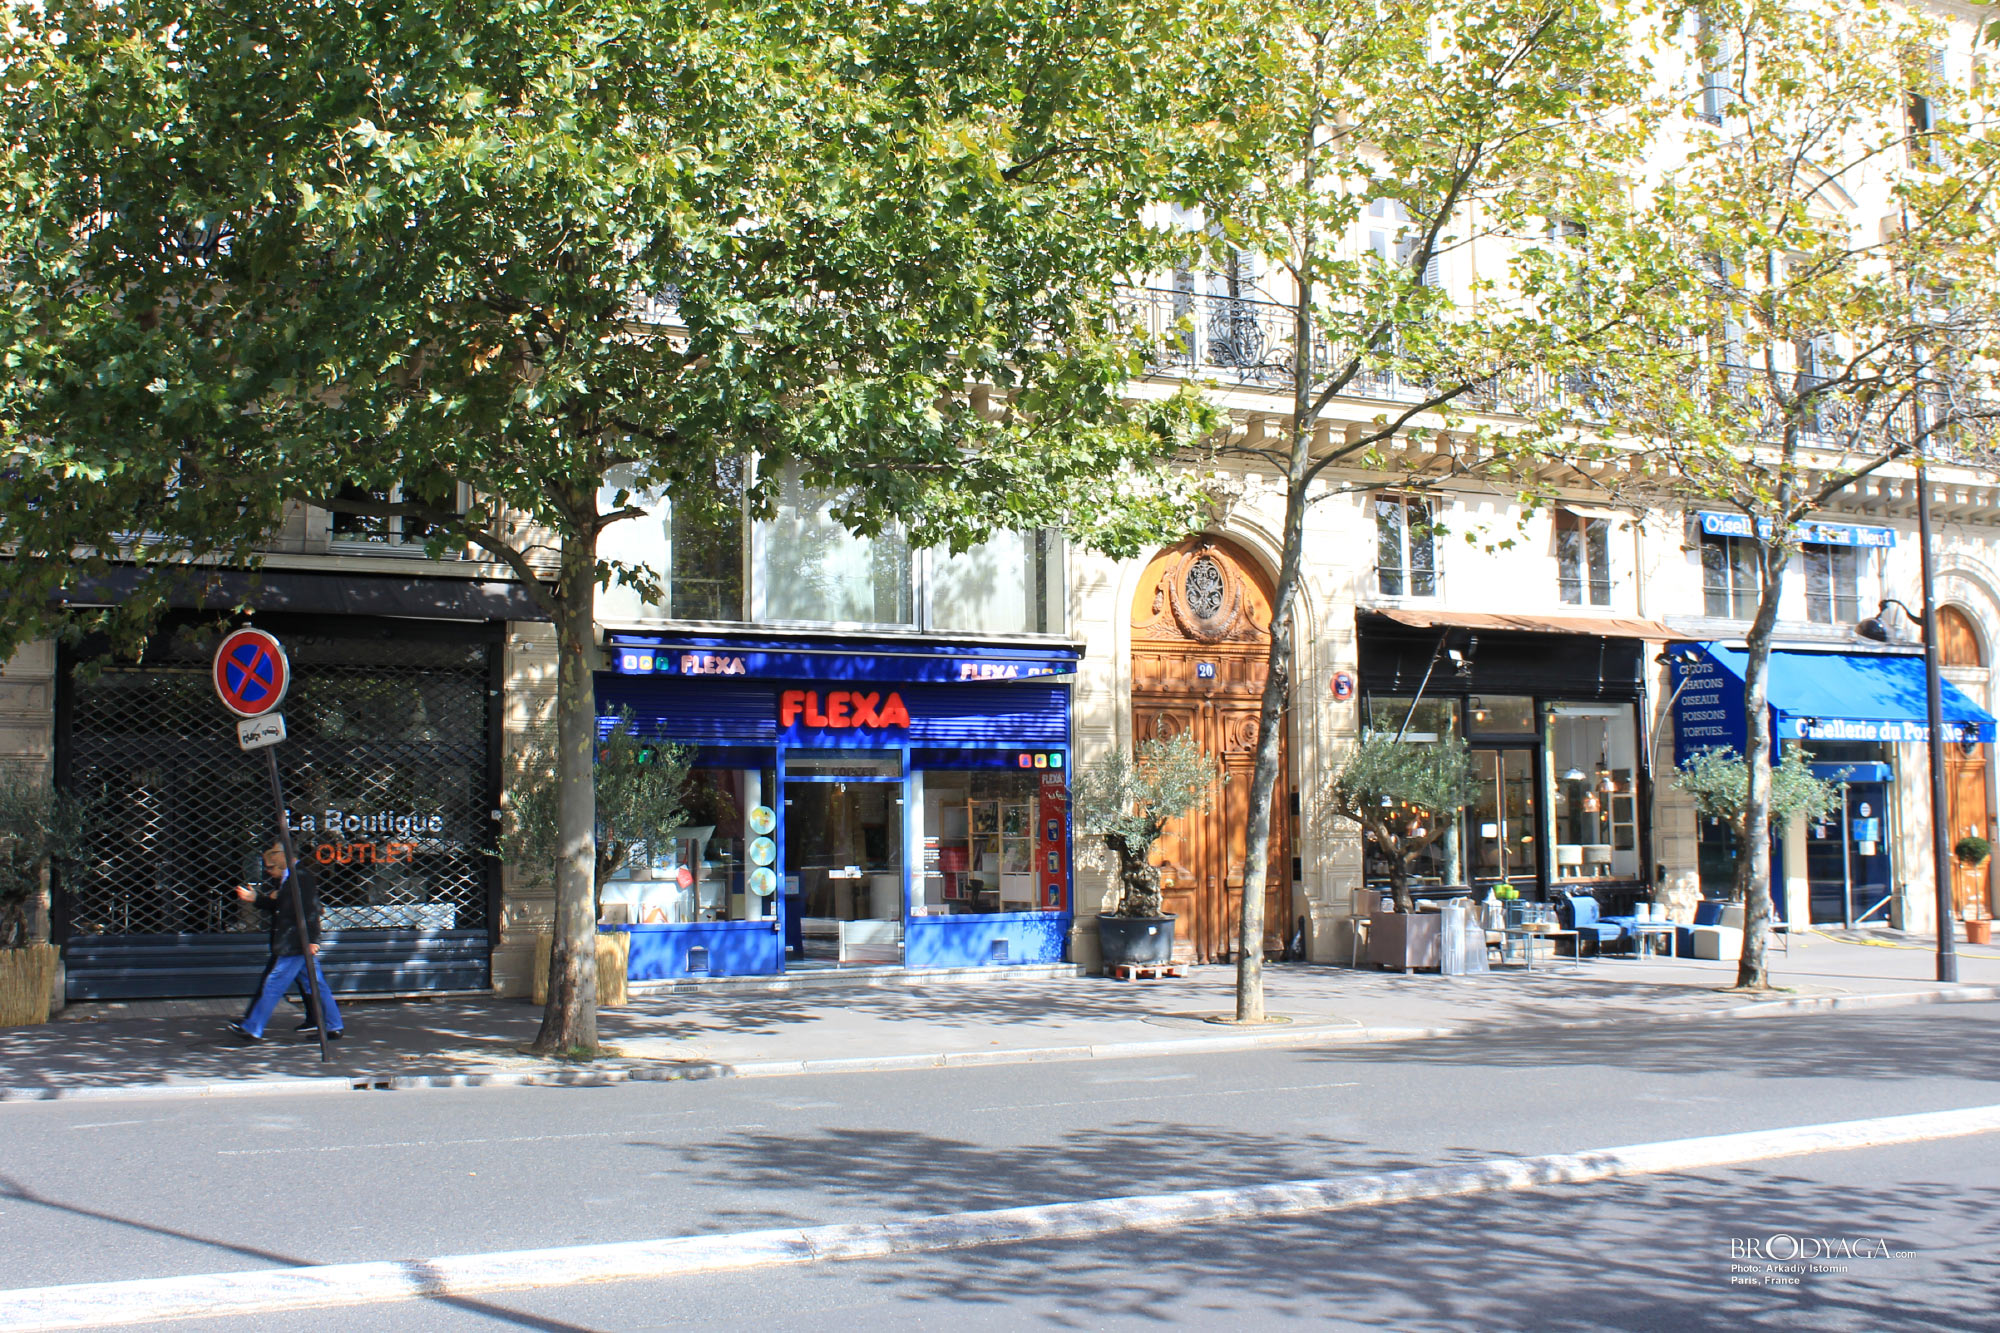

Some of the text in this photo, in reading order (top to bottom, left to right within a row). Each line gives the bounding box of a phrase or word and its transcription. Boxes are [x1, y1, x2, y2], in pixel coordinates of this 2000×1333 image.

[1856, 528, 1892, 546] Neuf
[681, 655, 746, 675] FLEXA
[960, 663, 1018, 680] FLEXA
[1199, 665, 1213, 677] 20
[781, 690, 911, 728] FLEXA
[1681, 694, 1720, 706] OISEAUX
[1682, 710, 1726, 721] POISSONS
[1795, 718, 1876, 740] Oisellerie
[1879, 721, 1903, 741] du
[1903, 721, 1930, 741] Pon
[284, 809, 443, 837] La Boutique
[315, 843, 418, 864] OUTLET
